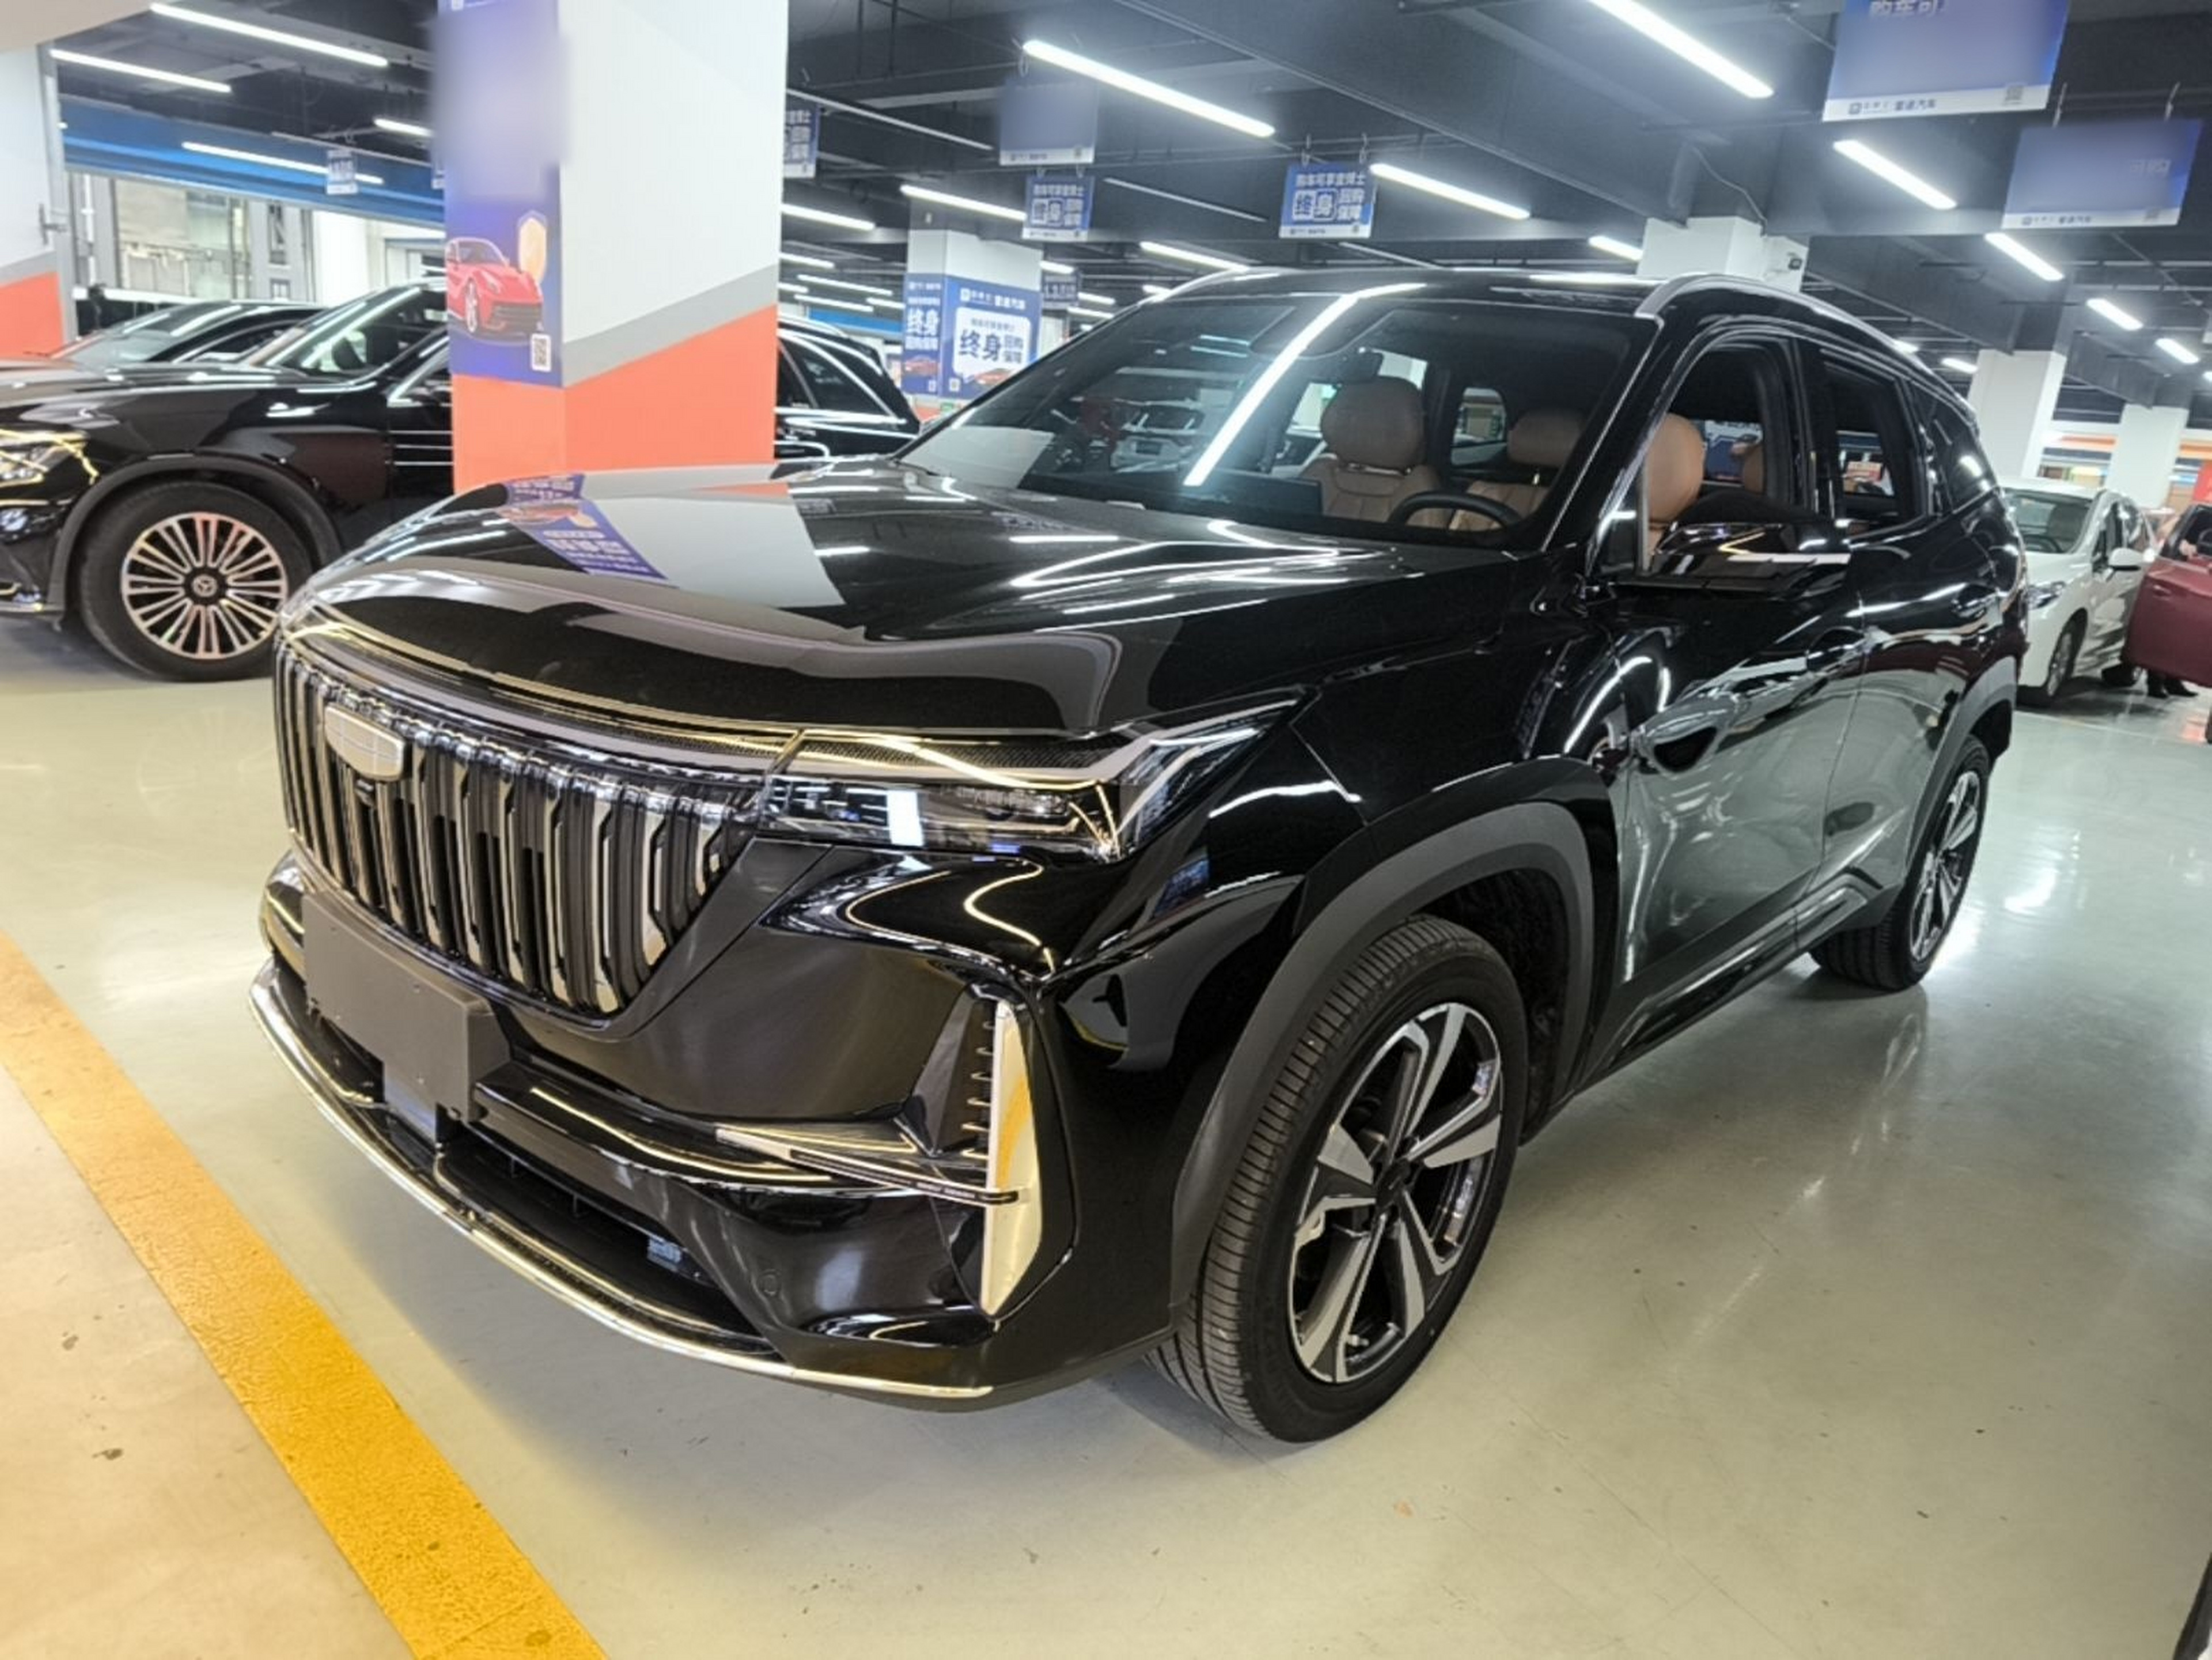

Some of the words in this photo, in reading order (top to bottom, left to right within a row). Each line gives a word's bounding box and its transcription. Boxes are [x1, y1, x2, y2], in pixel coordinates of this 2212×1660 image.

[1870, 0, 1944, 18] 购车可
[959, 329, 1002, 361] 终身
